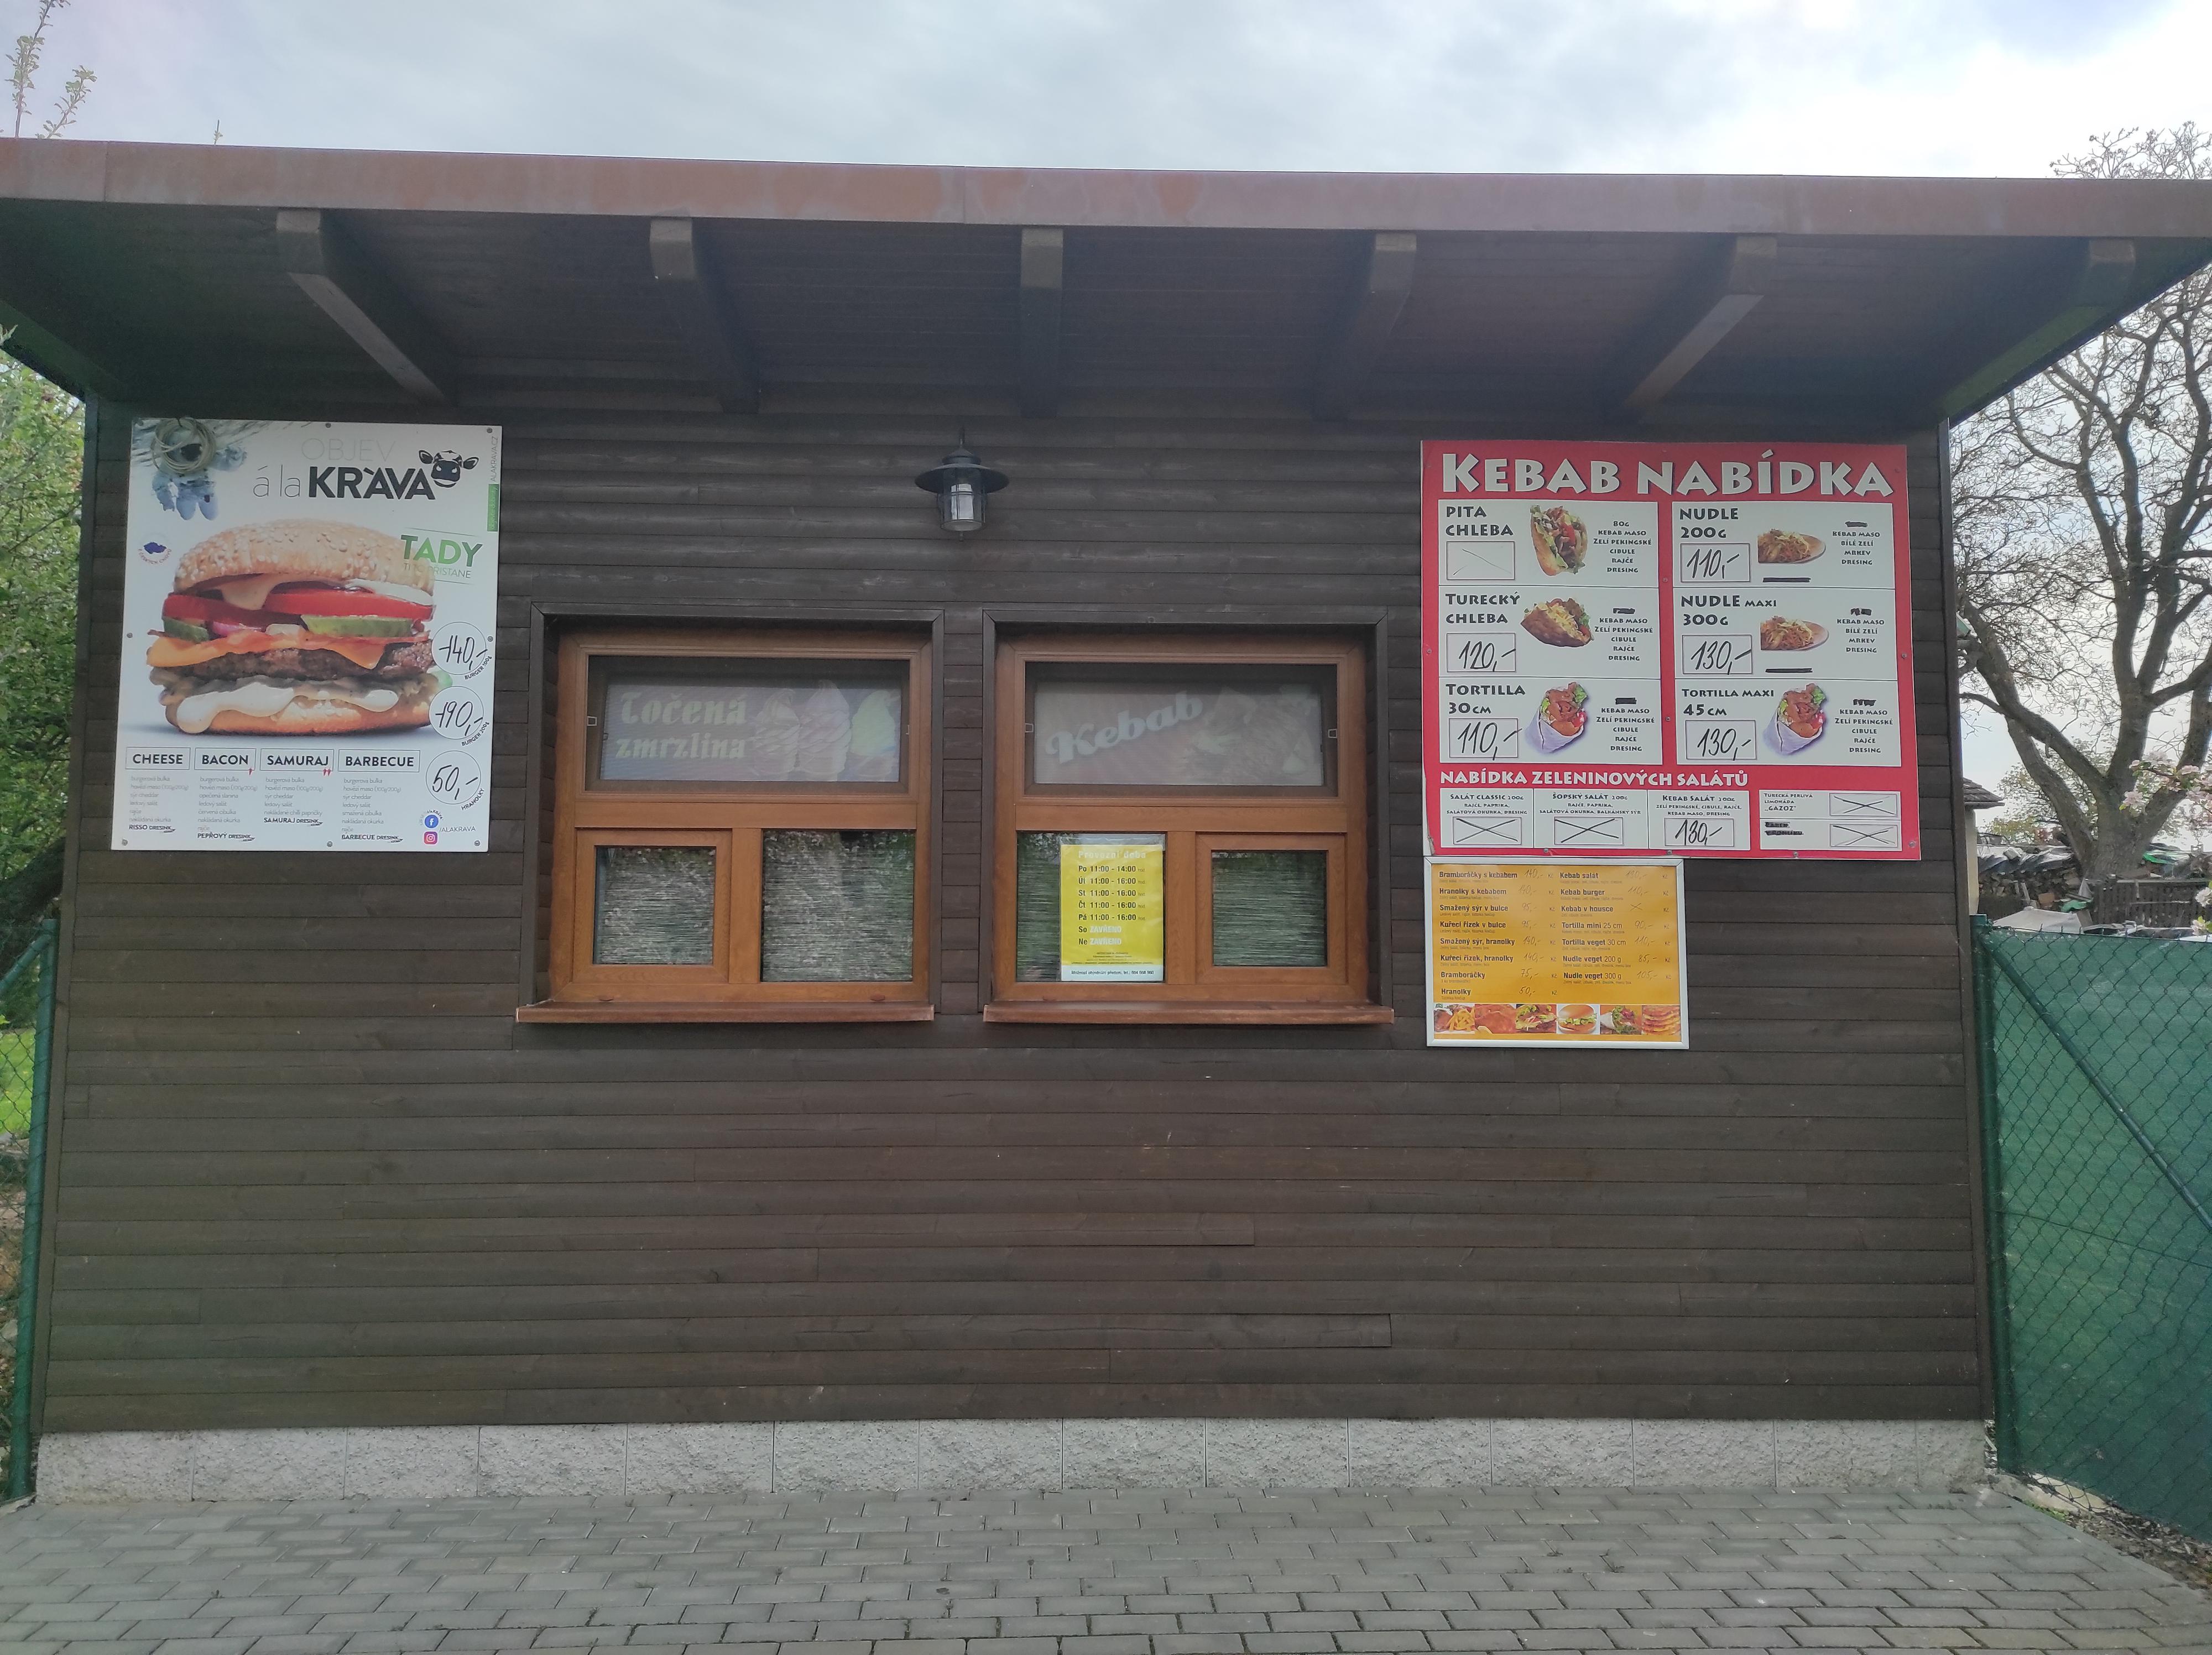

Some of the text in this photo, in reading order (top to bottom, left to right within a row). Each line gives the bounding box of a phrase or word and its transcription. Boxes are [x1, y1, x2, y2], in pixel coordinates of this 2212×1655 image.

[301, 438, 395, 462] OBJEV
[280, 464, 301, 498] la
[1443, 449, 1893, 497] KEBAB NABÍDKA
[1447, 506, 1486, 518] PITA
[1680, 508, 1739, 520] NUDLE
[1446, 524, 1514, 536] CHLEBA
[1611, 537, 1652, 546] PEKINGSKÉ
[401, 535, 483, 567] TADY
[1687, 549, 1740, 578] 110,-
[1445, 591, 1521, 605] TURECKÝ
[1681, 595, 1740, 607] NUDLE
[1446, 614, 1508, 624] CHLEBA
[1458, 641, 1516, 672] 120,-
[1691, 641, 1752, 675] 130,-
[465, 656, 492, 680] BURGER 100g
[1446, 683, 1525, 695] TORTILLA
[1682, 688, 1775, 697] TORTILLA MAXI
[620, 692, 748, 725] Točená
[1449, 702, 1491, 714] 30CM
[1683, 704, 1727, 716] 45CM
[461, 722, 490, 746] BURGER 200g
[1045, 690, 1203, 765] Kebab
[615, 733, 745, 759] zmrzlina
[1458, 721, 1522, 760] 110,-
[1697, 728, 1751, 760] 130,-
[132, 754, 183, 764] CHEESE
[202, 755, 248, 765] BACON
[267, 755, 329, 766] SAMURAJ
[346, 756, 414, 767] BARBECUE
[1441, 768, 1748, 786] NABÍDKA ZELENINOVÝCH SALÁTŮ
[461, 788, 484, 811] HRANOLKY
[1553, 791, 1582, 800] ŠOPSKÝ
